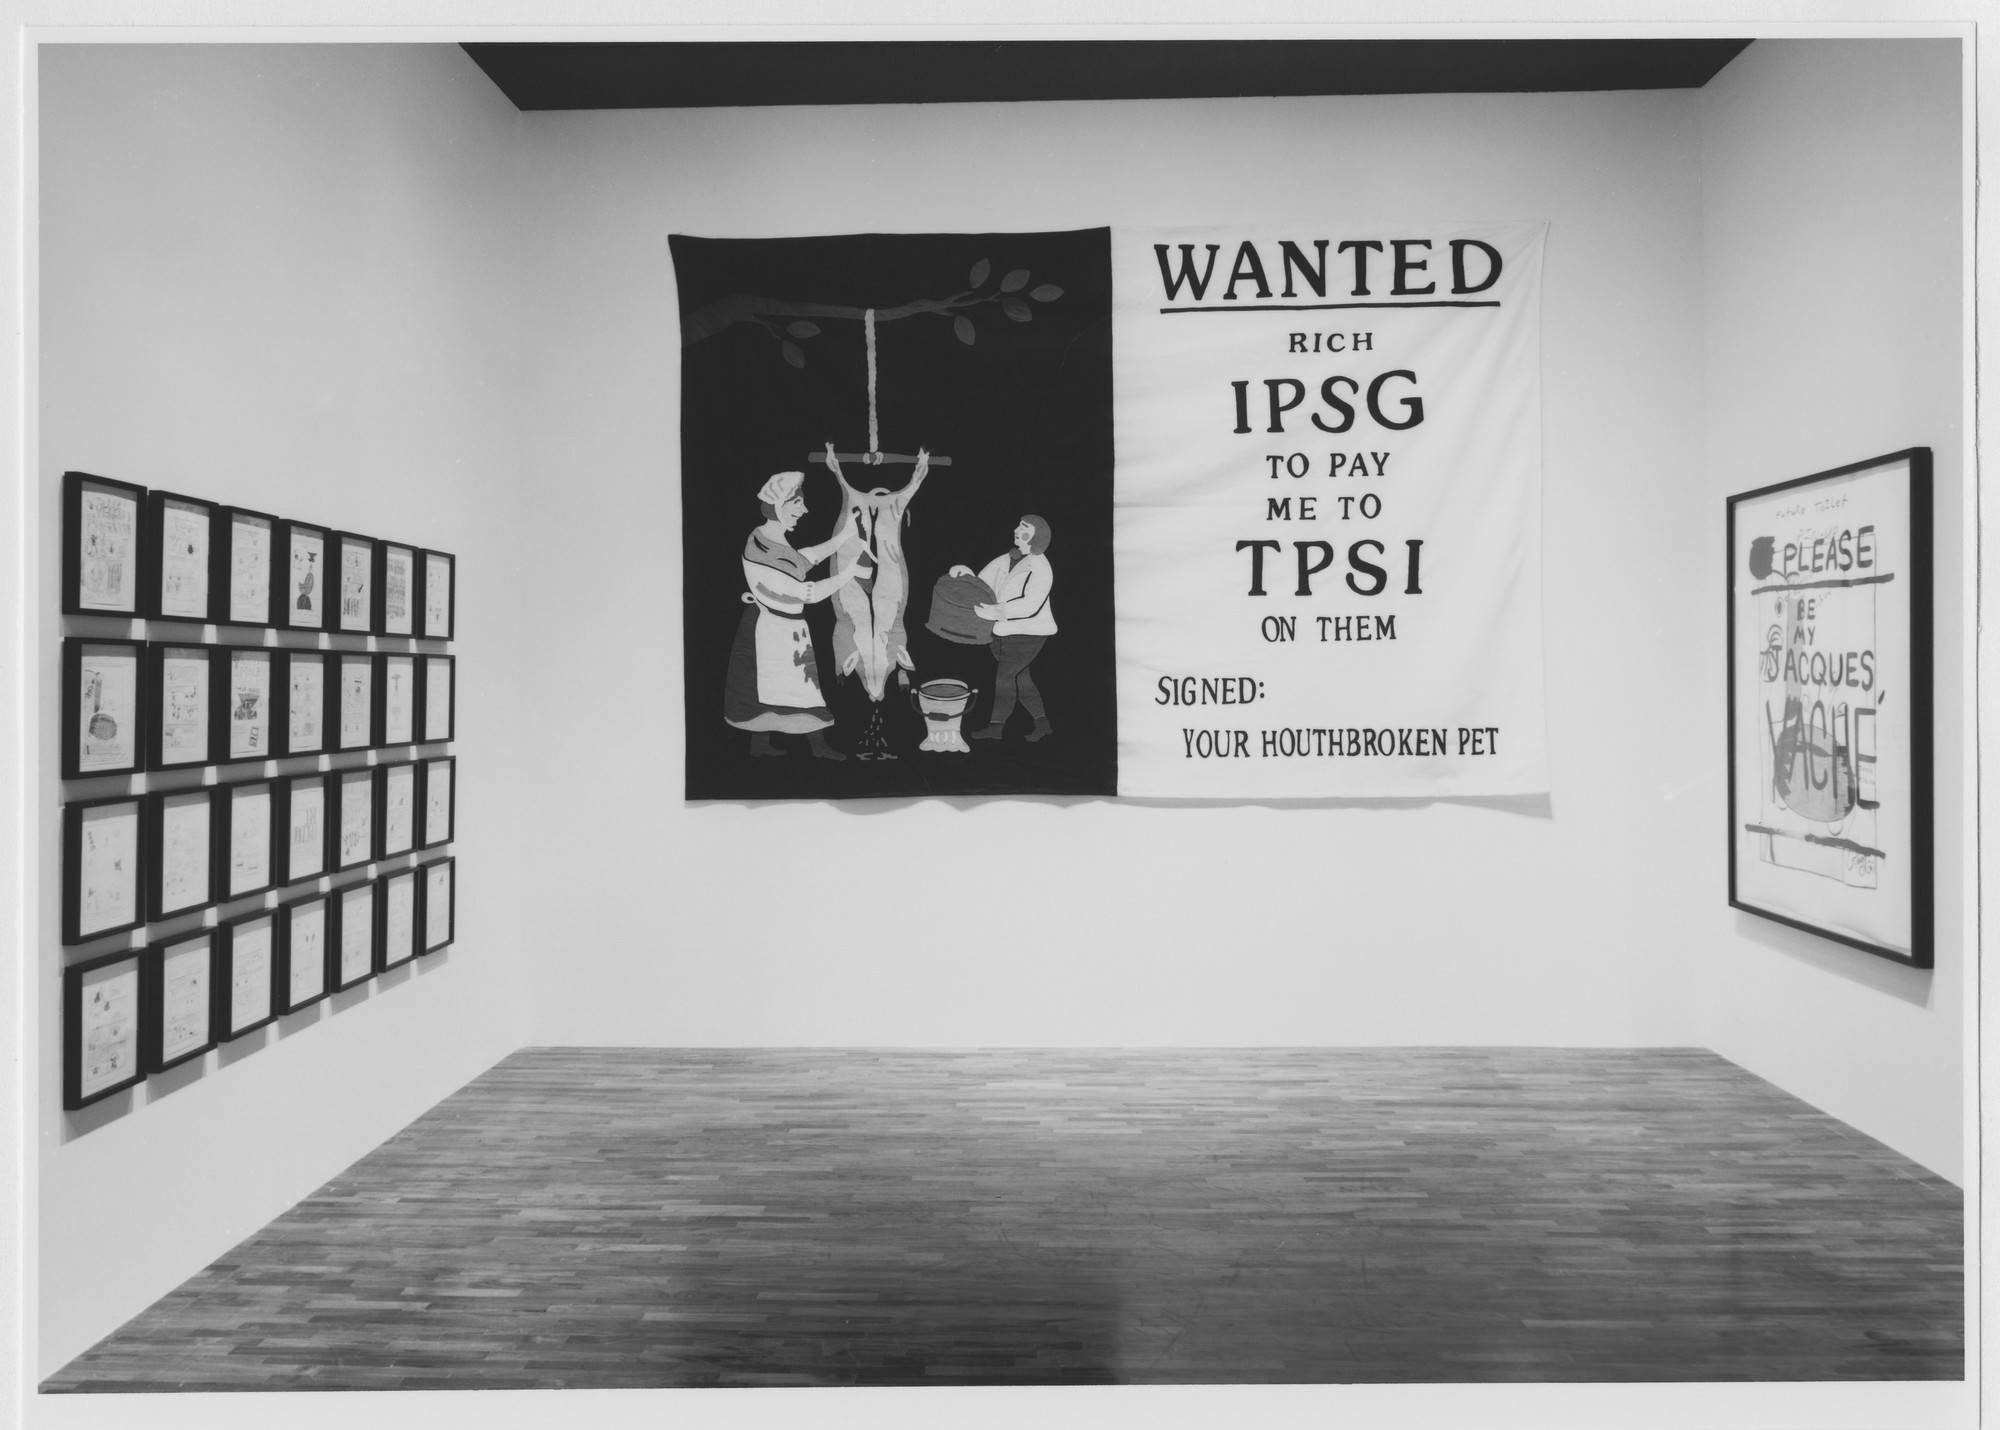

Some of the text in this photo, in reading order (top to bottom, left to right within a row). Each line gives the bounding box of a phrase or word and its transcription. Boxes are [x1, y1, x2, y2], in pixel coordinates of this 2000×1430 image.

[1154, 239, 1503, 301] WANTED
[1288, 332, 1373, 353] RICH
[1231, 369, 1425, 434] IPSG
[1266, 451, 1391, 479] TO PAY
[1266, 493, 1382, 521] ME TO
[1783, 525, 1875, 576] PLEASE
[1235, 539, 1424, 597] TPSI
[1796, 599, 1816, 621] BE
[1261, 615, 1397, 643] ON THEM
[1793, 625, 1816, 646] MY
[1154, 675, 1265, 706] SIGNED:
[1182, 727, 1499, 759] YOUR HOUTHBROKEN PET
